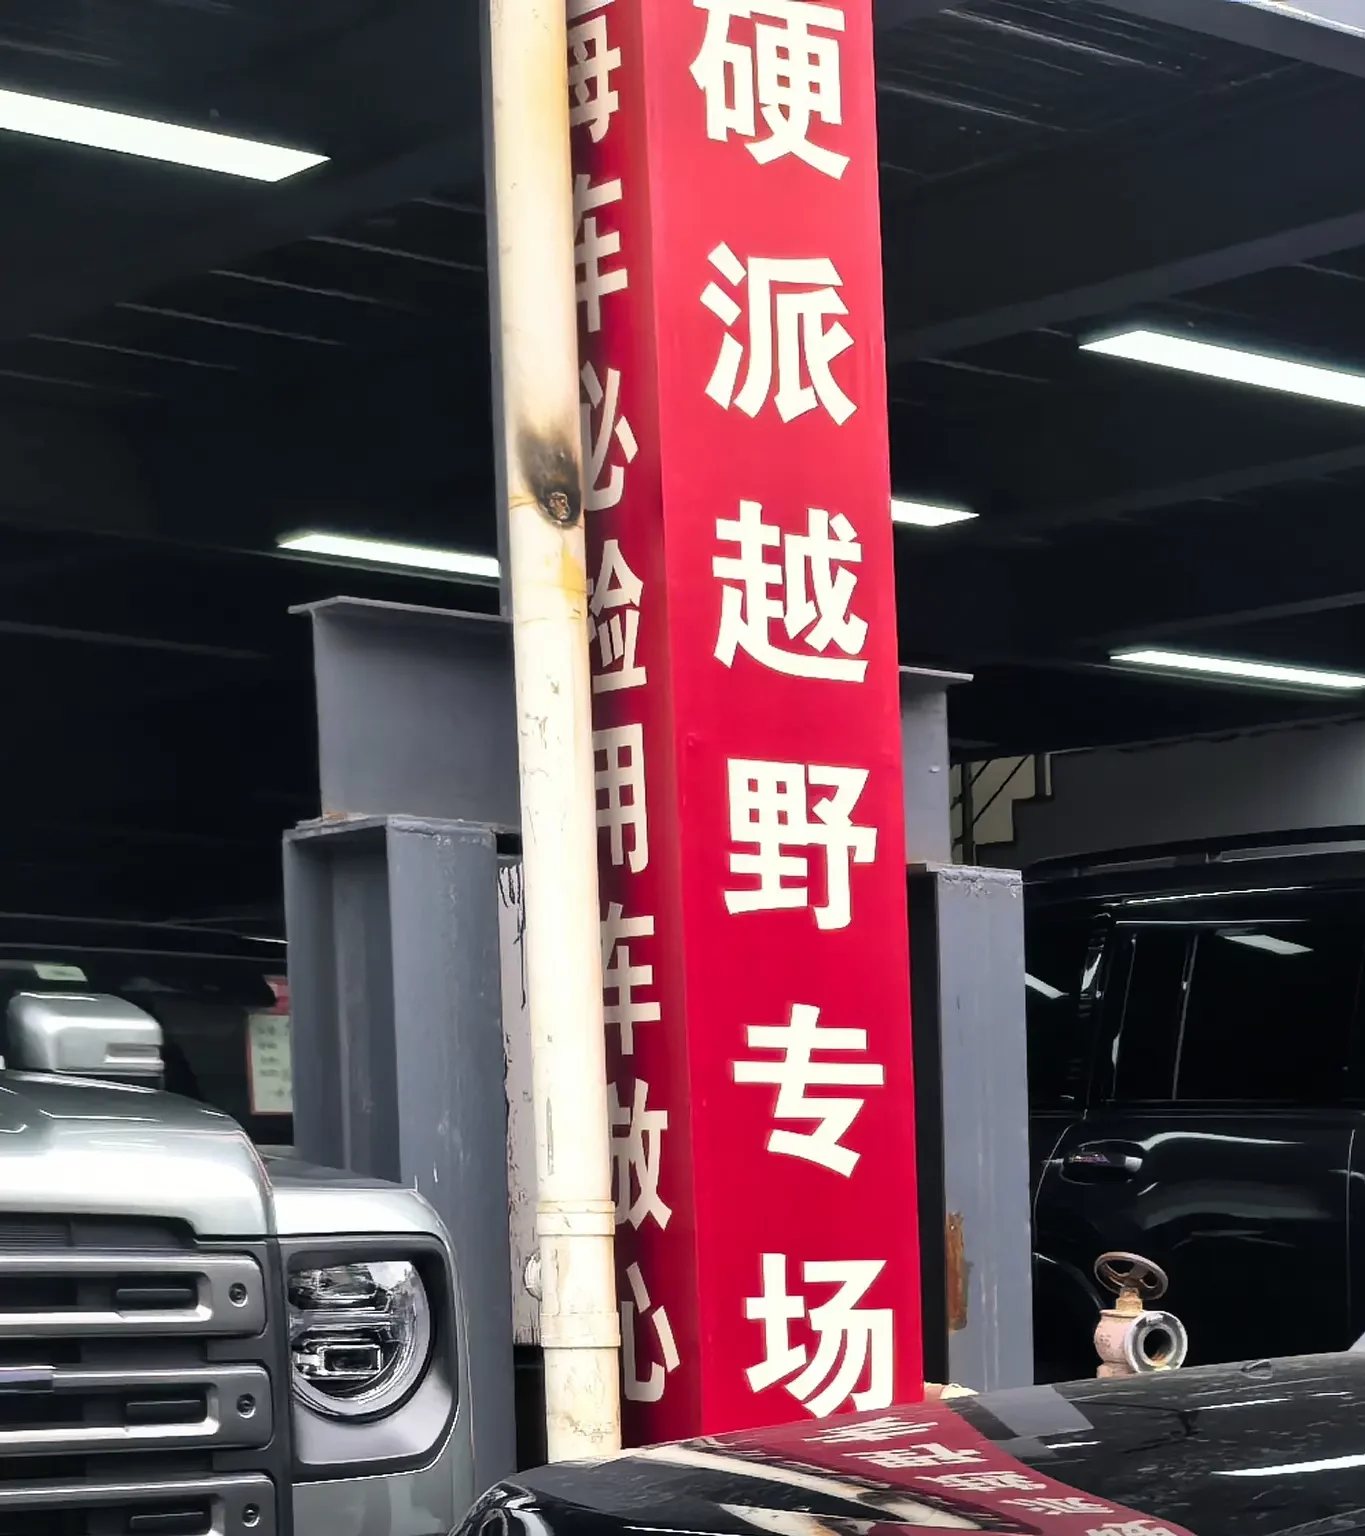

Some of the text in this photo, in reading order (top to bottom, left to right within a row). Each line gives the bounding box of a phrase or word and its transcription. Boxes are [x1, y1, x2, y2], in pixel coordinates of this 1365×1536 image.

[690, 0, 894, 1419] 硬派越野专场
